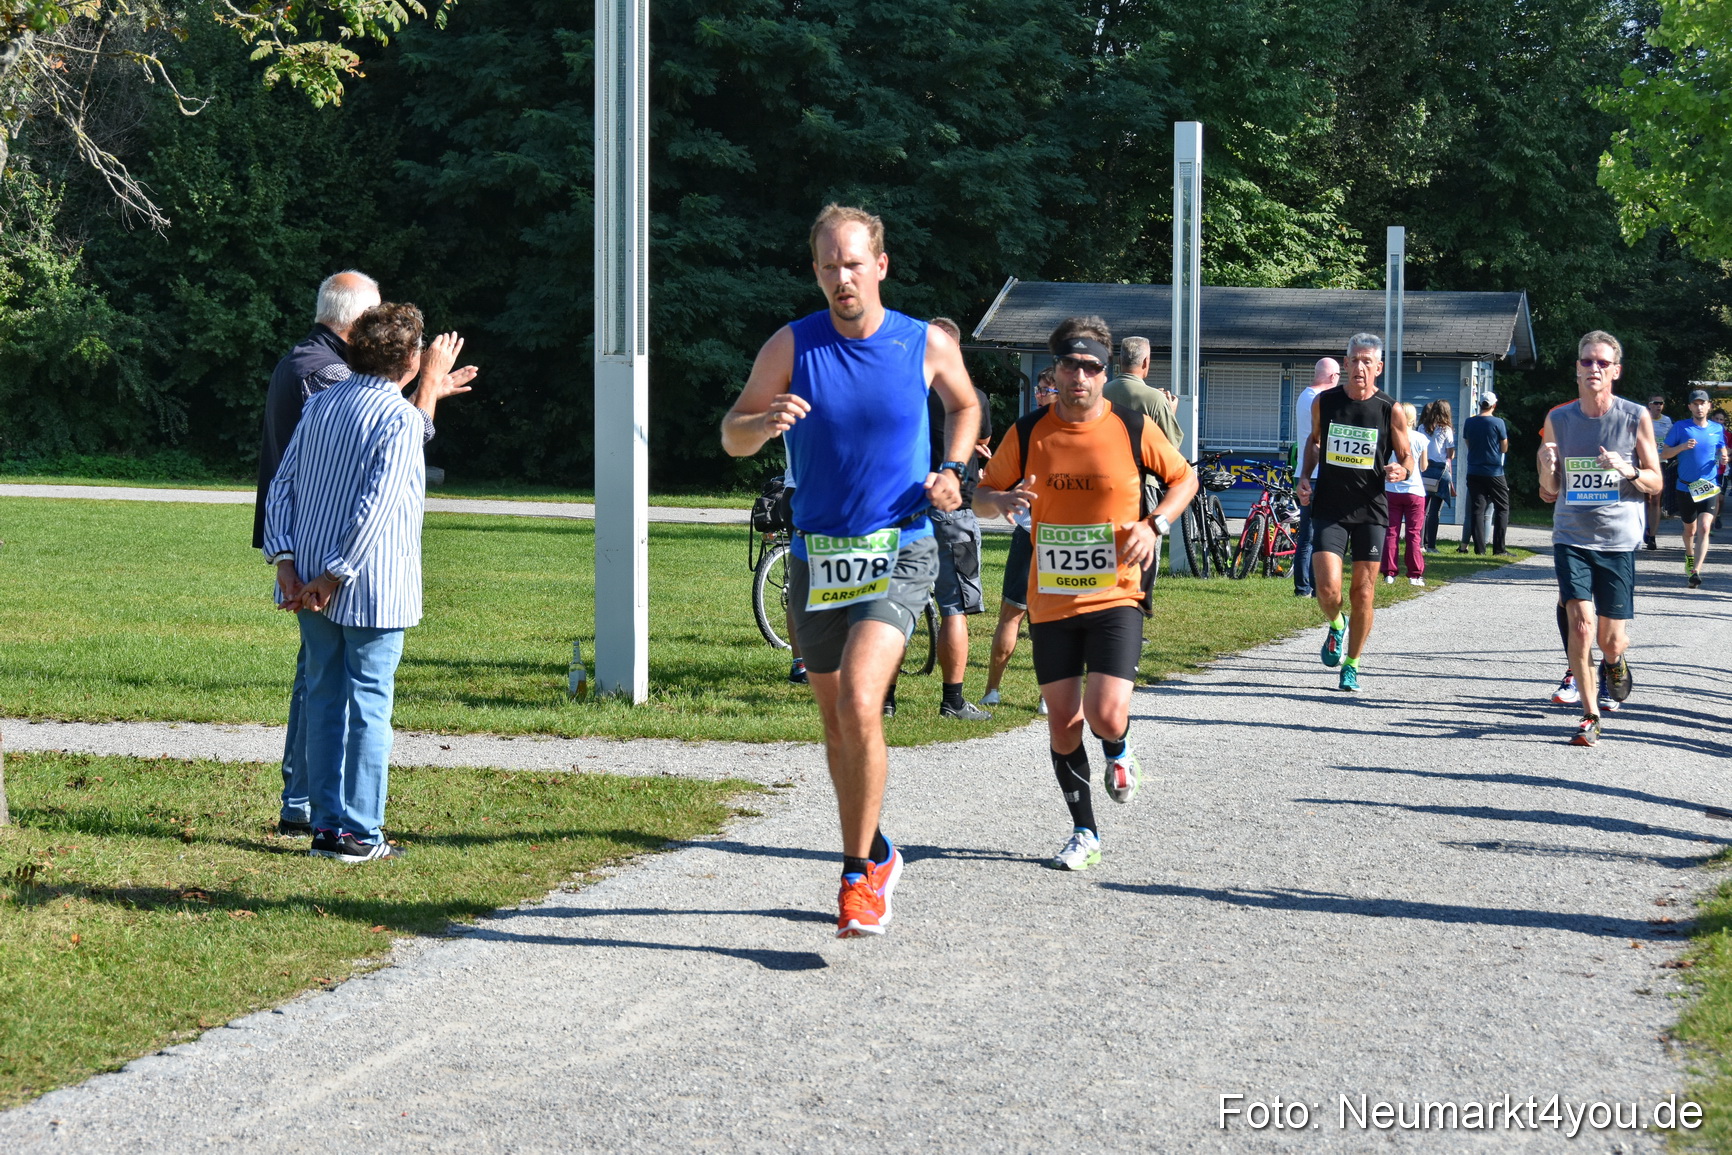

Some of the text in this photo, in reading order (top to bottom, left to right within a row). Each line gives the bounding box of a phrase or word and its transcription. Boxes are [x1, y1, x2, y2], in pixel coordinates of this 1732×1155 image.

[1332, 426, 1372, 439] BOCK
[1334, 440, 1370, 455] 1126
[1335, 455, 1364, 464] RUDOLF
[1572, 474, 1614, 488] 2034
[1693, 483, 1715, 495] 1384
[812, 532, 891, 552] BOCK
[1041, 527, 1106, 543] BOCK
[1045, 548, 1107, 571] 1256
[820, 557, 889, 583] 1078
[1056, 576, 1097, 587] GEORG
[821, 583, 877, 602] CARSTEN
